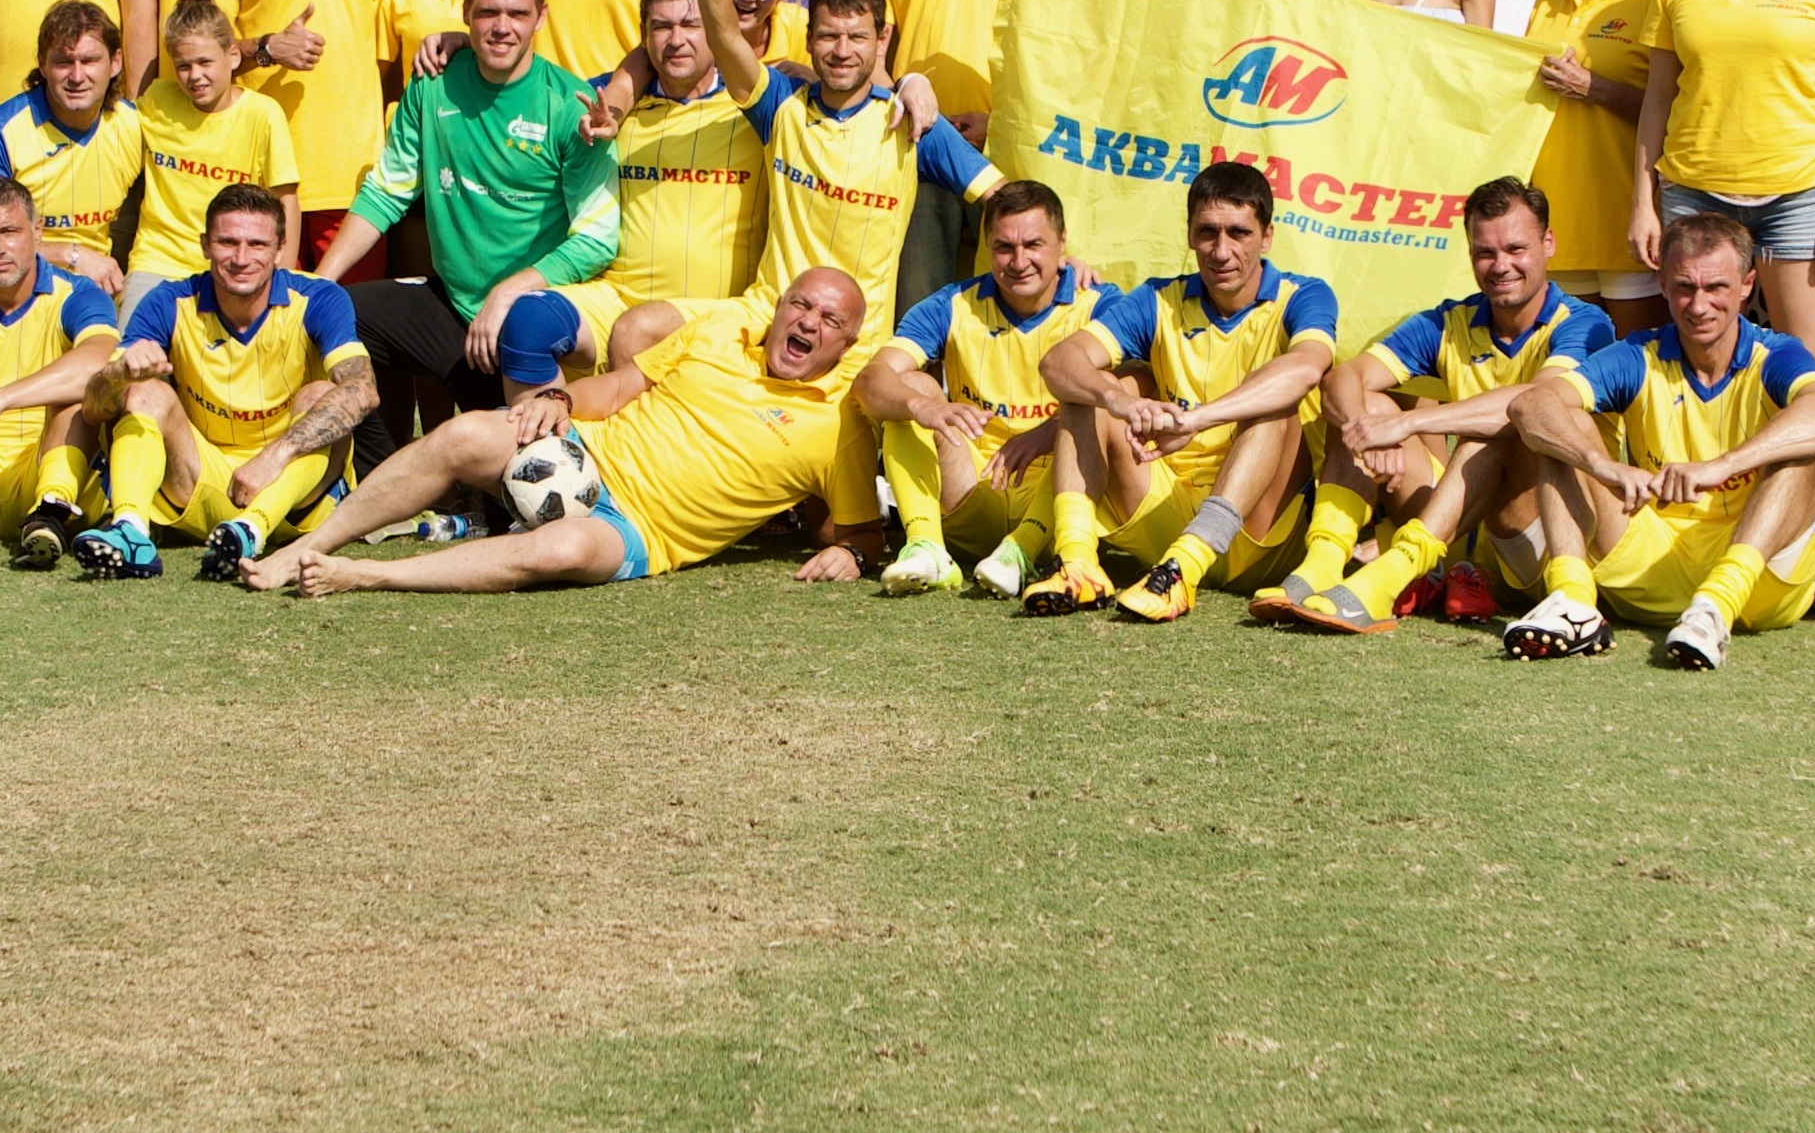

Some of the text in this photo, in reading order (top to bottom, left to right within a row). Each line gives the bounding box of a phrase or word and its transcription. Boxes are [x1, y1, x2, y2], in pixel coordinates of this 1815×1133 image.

[153, 151, 253, 184] ВАМАСТЕ
[44, 208, 121, 228] ВАМАС
[1273, 210, 1449, 251] .aquamaster.ru
[961, 385, 1060, 420] АКВАМАС
